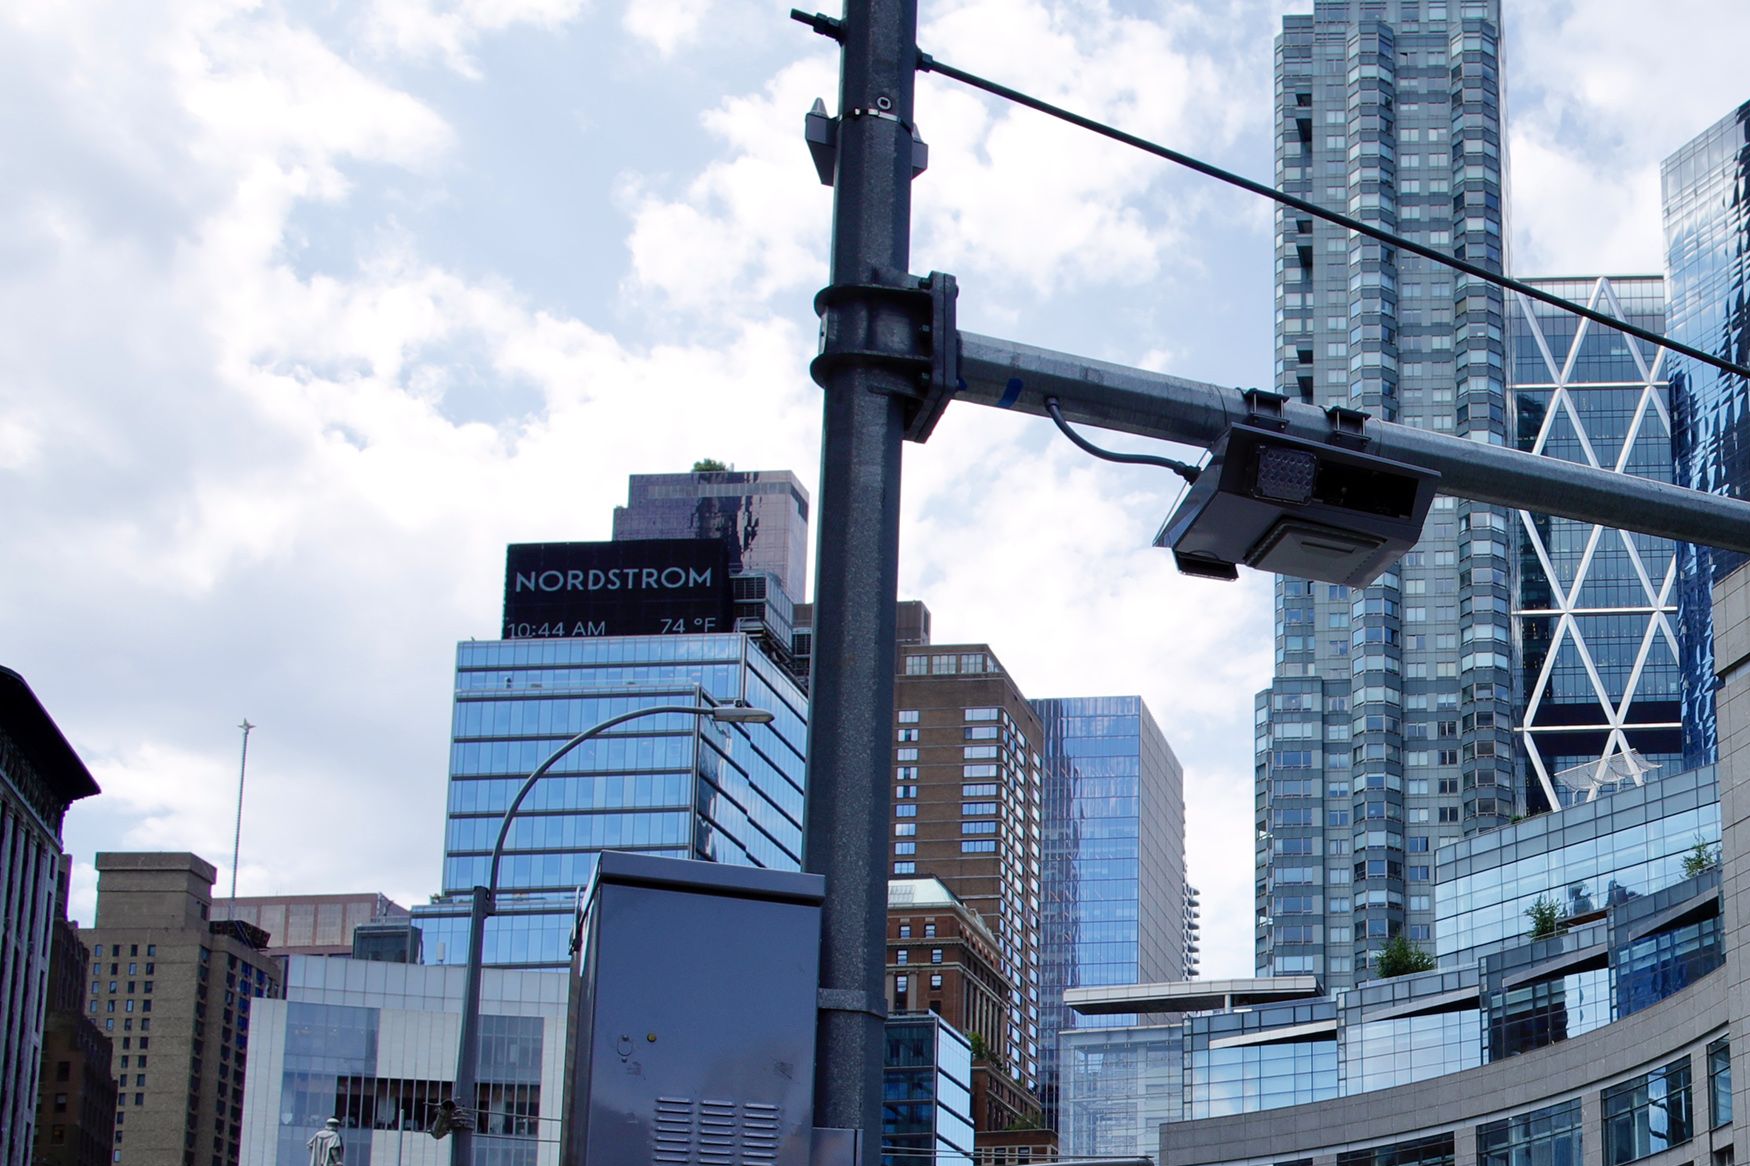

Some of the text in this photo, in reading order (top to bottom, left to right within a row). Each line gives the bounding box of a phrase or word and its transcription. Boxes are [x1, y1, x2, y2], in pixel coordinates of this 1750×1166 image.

[515, 566, 712, 592] NORDSTROM
[506, 621, 565, 638] 10:44
[572, 621, 606, 637] AM
[660, 618, 685, 634] 74
